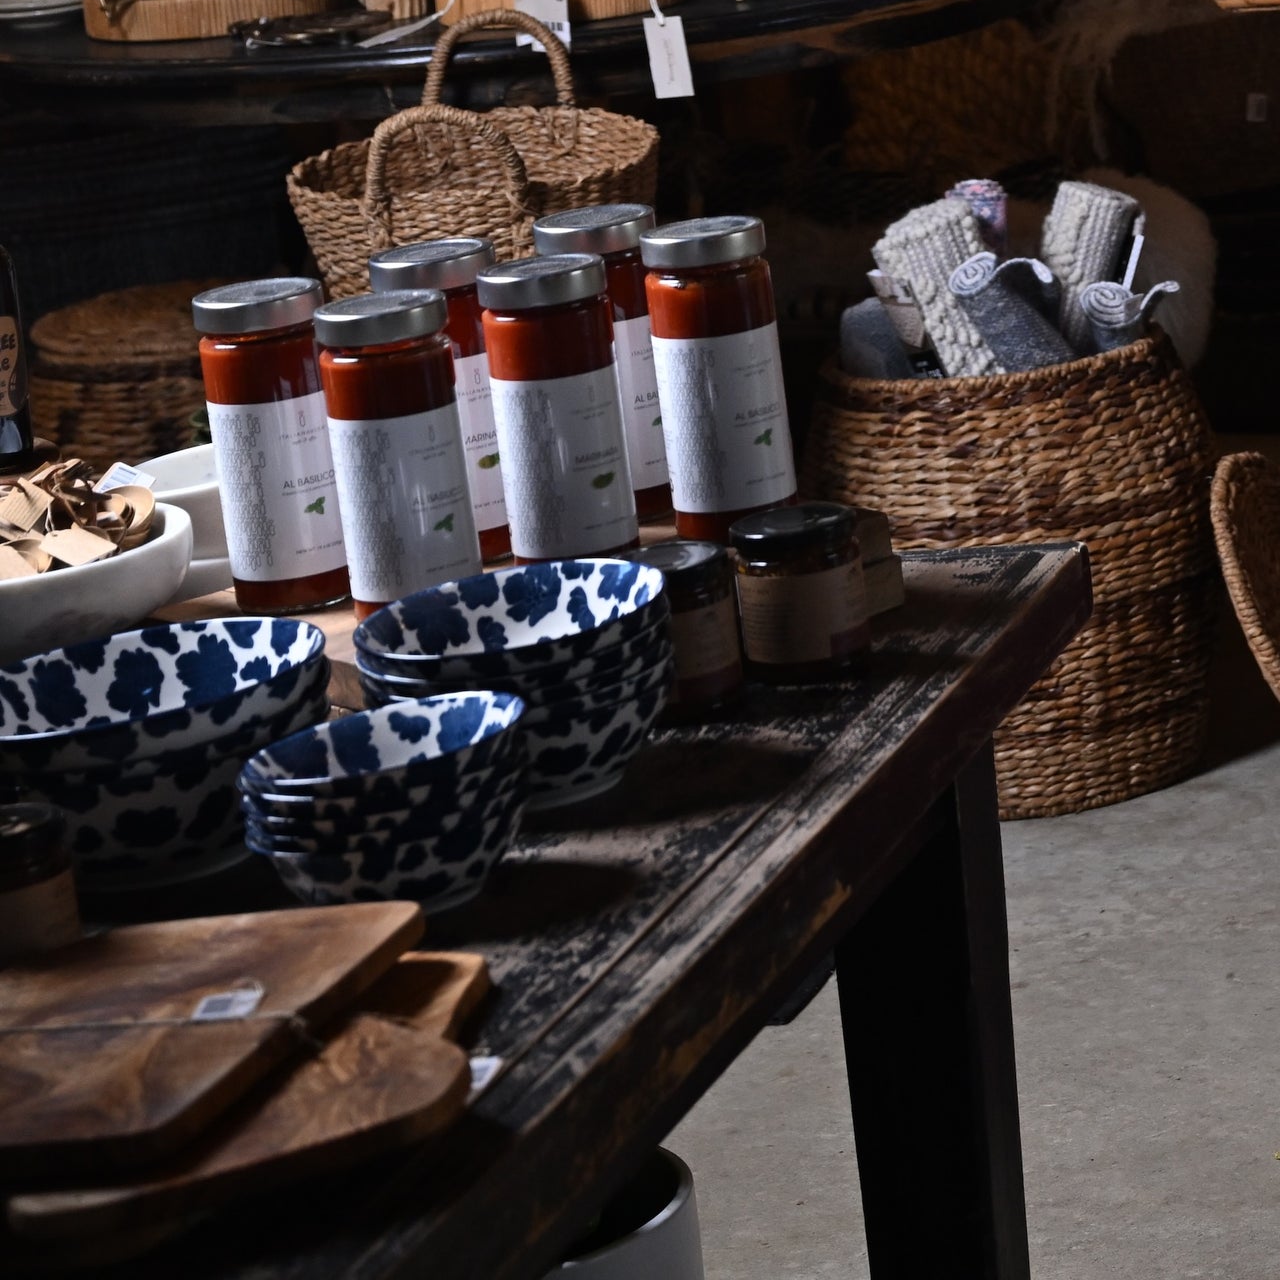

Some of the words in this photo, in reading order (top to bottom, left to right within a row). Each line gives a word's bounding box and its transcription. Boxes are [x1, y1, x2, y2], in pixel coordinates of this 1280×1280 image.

[634, 395, 646, 404] AL
[283, 480, 296, 489] AL
[298, 468, 336, 488] BASILICO
